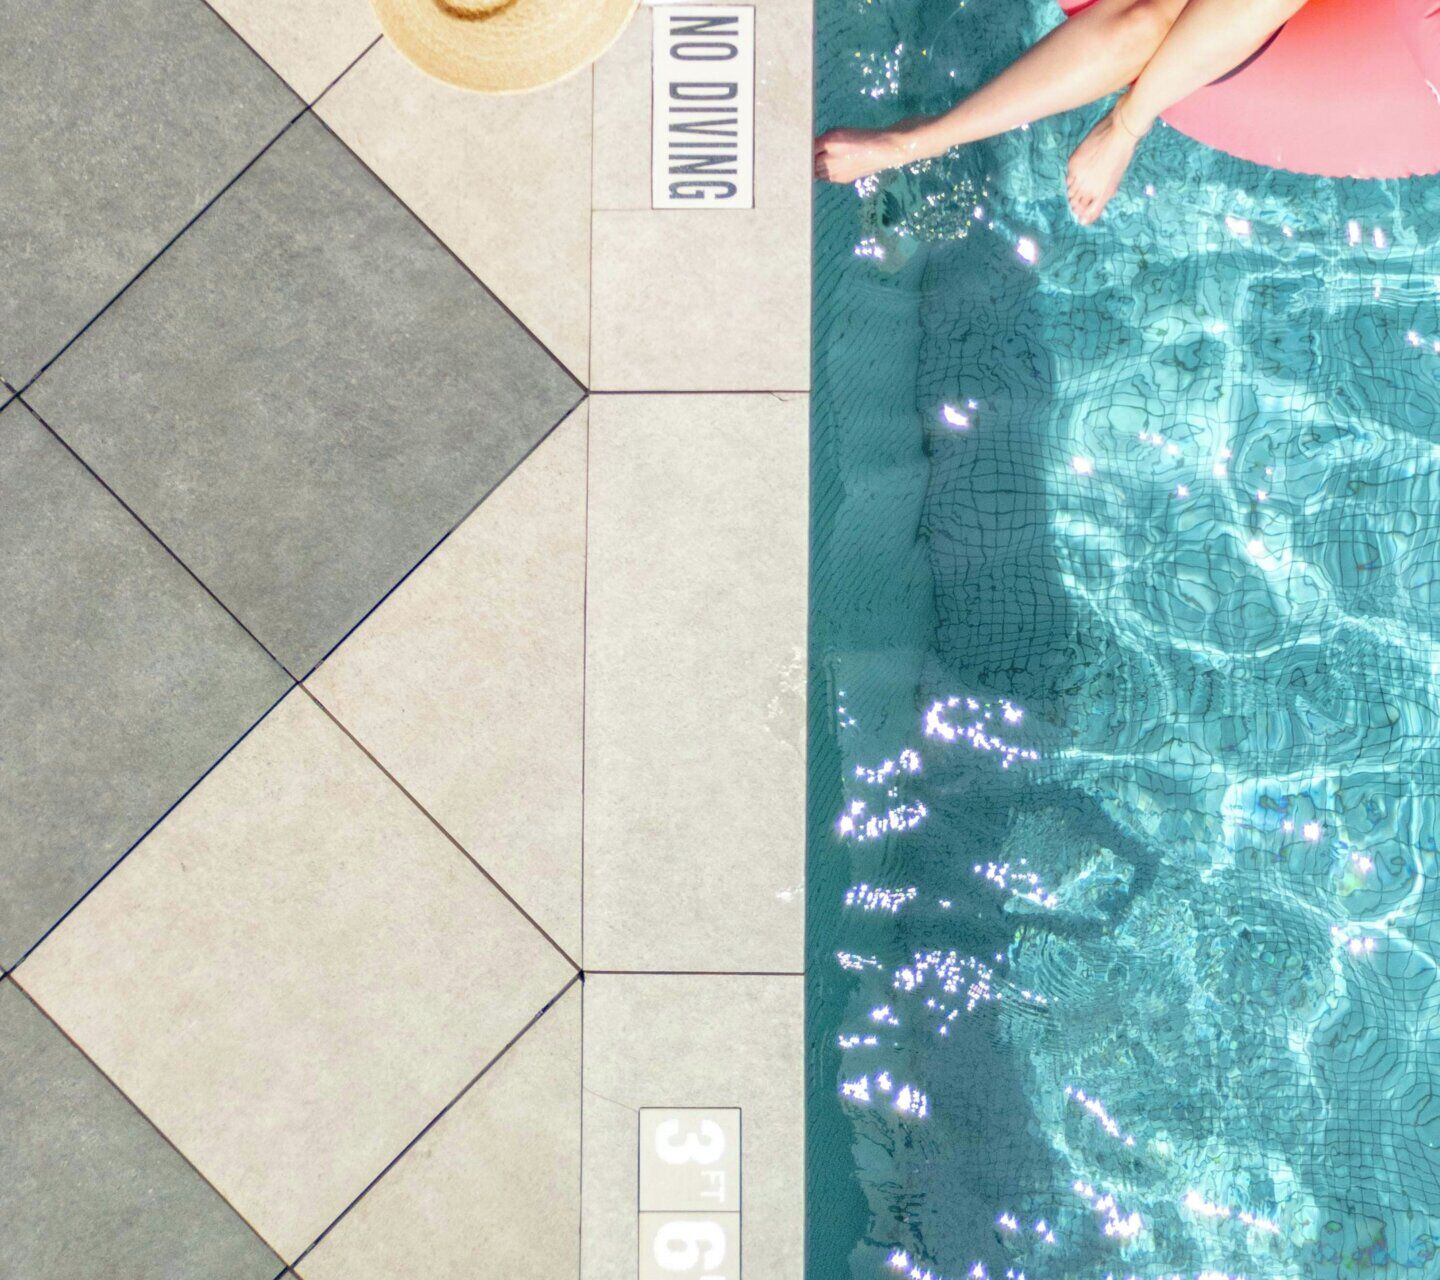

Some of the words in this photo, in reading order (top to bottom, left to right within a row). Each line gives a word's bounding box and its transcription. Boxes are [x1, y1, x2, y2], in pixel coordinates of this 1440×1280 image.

[669, 16, 739, 61] NO
[668, 82, 738, 199] DIVING
[655, 1118, 725, 1165] 3
[700, 1170, 725, 1202] FT
[653, 1220, 726, 1271] 6
